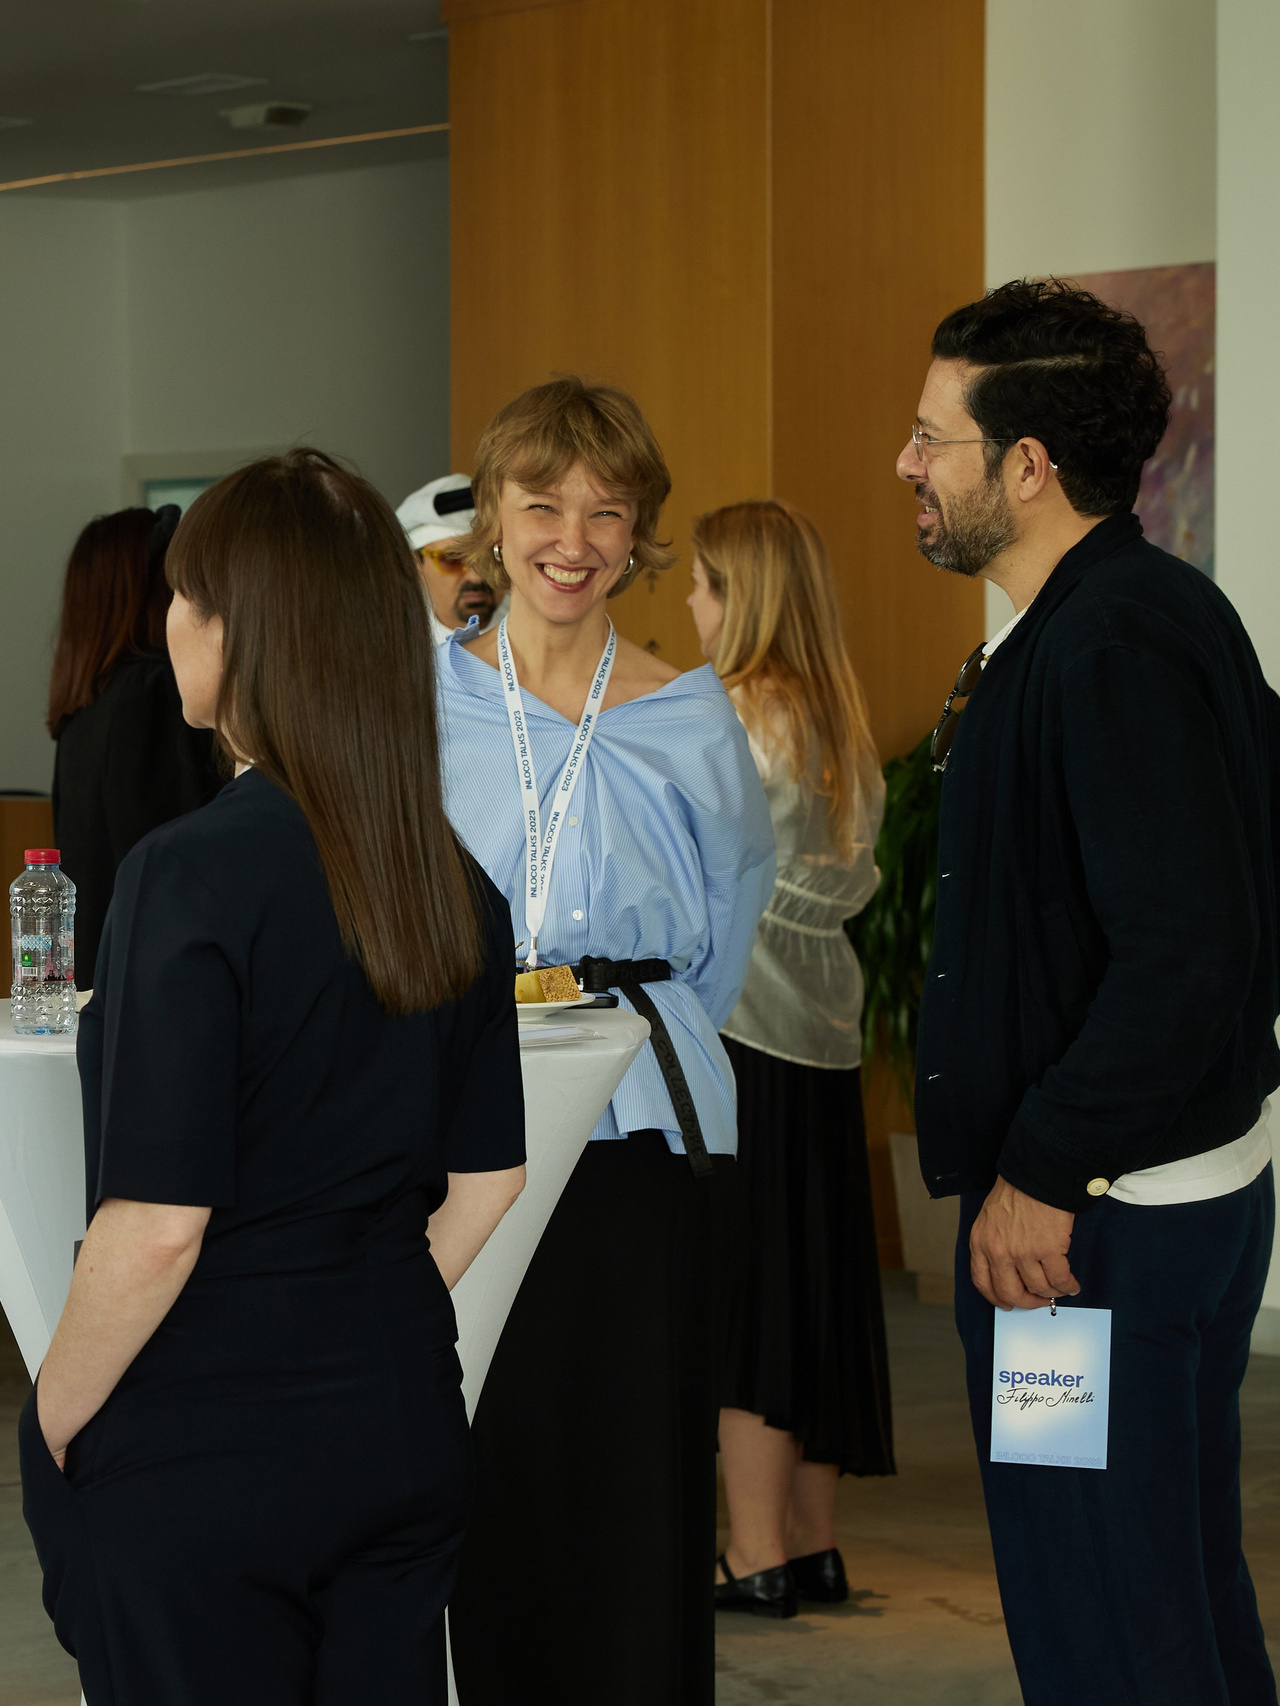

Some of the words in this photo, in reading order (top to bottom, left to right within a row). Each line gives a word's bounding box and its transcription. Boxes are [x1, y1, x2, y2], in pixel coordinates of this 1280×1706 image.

[500, 638, 509, 662] TALKS
[503, 662, 516, 692] INLOCO
[597, 656, 611, 680] TALKS
[591, 679, 603, 700] 2023
[513, 710, 524, 732] 2023
[579, 714, 593, 741] INLOCO
[517, 733, 528, 758] TALKS
[569, 742, 584, 768] TALKS
[522, 759, 533, 790] INLOCO
[561, 769, 575, 792] 2023
[528, 809, 537, 833] 2023
[546, 811, 561, 844] INLOCO
[529, 835, 537, 862] TALKS
[540, 845, 551, 872] TALKS
[530, 864, 538, 898] INLOCO
[998, 1369, 1085, 1388] speaker
[996, 1387, 1045, 1411] Filippo
[995, 1450, 1037, 1462] INLOCO
[1037, 1453, 1072, 1465] TALKS
[1073, 1456, 1103, 1468] 2023
